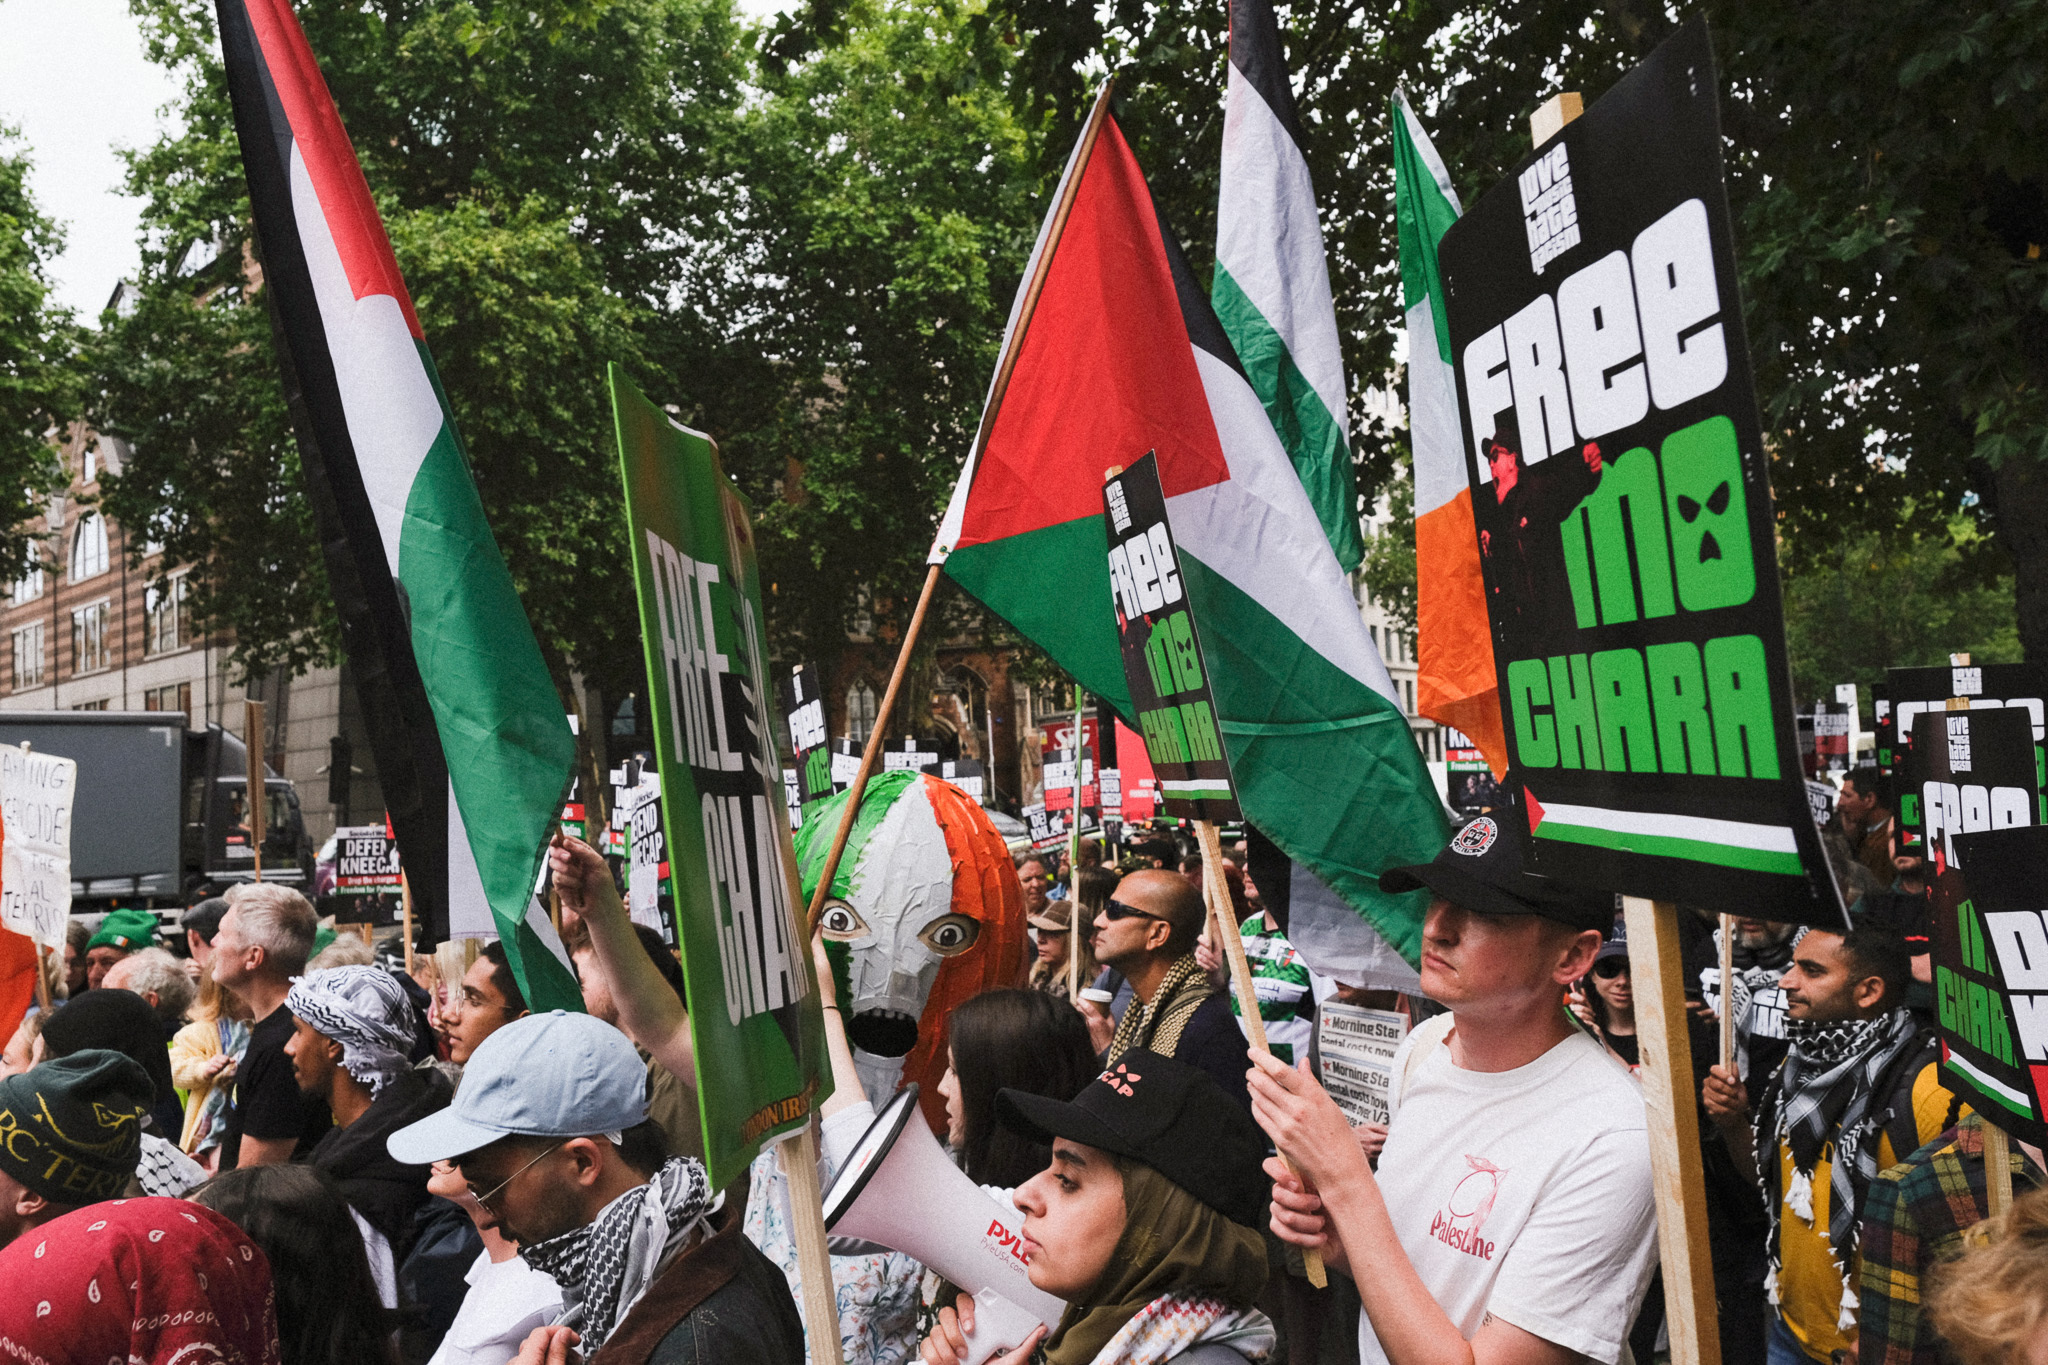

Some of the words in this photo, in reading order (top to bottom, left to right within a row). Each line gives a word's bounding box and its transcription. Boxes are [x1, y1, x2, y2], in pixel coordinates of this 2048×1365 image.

[646, 527, 744, 772] FREE
[1140, 701, 1222, 764] CHARA
[1507, 634, 1782, 780] CHARA
[346, 839, 387, 857] DEFEN
[1333, 1016, 1375, 1036] Morning
[1376, 1023, 1400, 1039] Star
[1937, 965, 2019, 1070] CHAR
[1333, 1061, 1369, 1084] Morning
[1370, 1071, 1390, 1088] Sta
[1373, 1109, 1390, 1126] 1/3
[1429, 1209, 1496, 1261] Palestine
